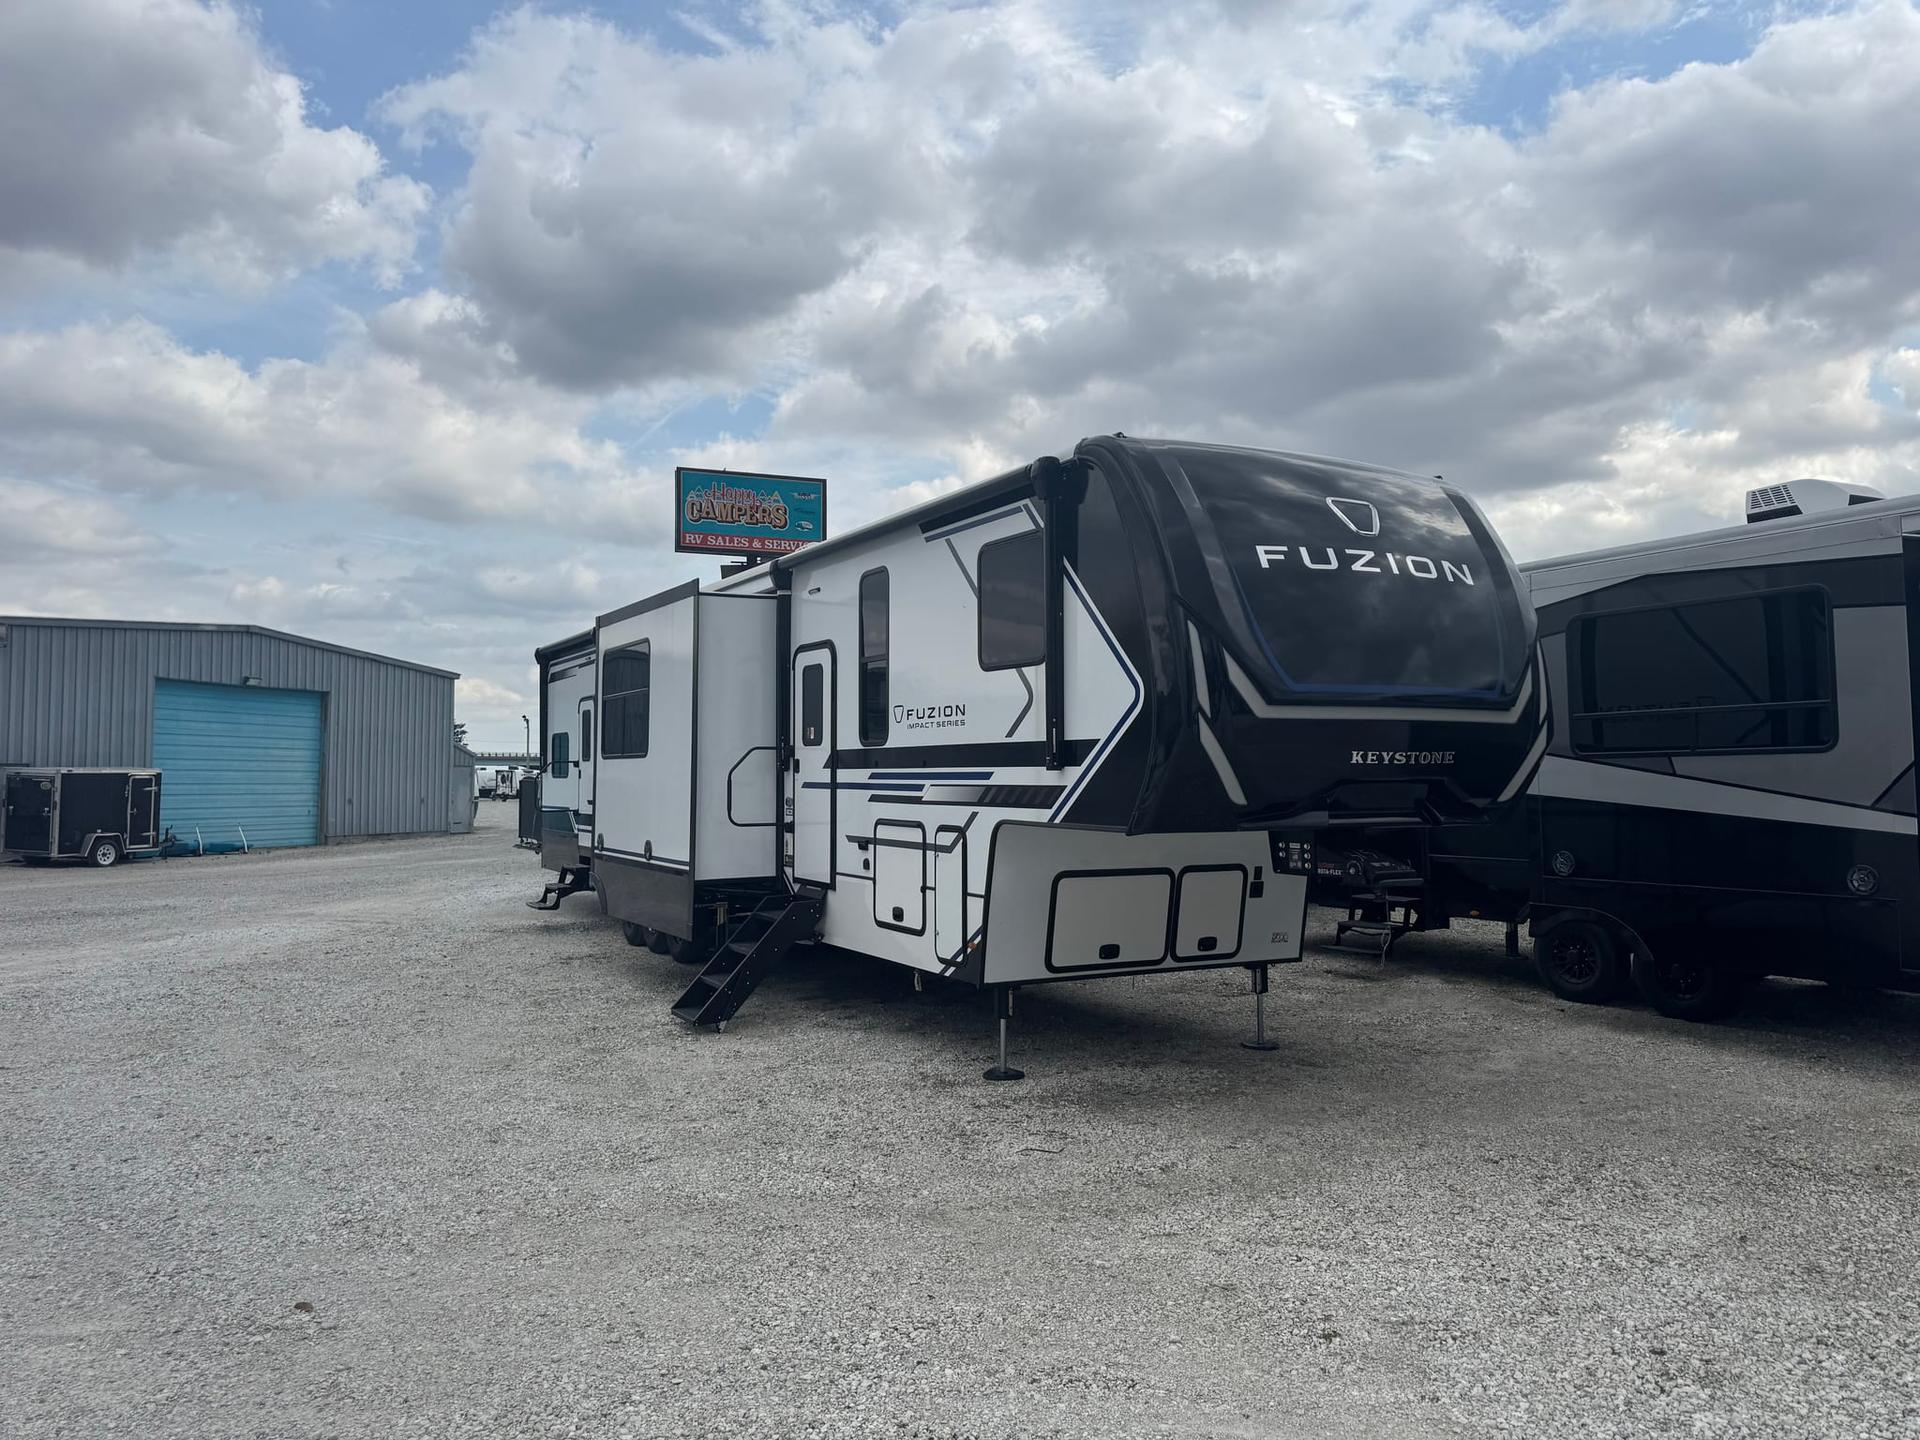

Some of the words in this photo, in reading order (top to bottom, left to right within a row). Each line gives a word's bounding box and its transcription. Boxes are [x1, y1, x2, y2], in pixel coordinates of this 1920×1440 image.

[704, 482, 762, 511] Happy
[686, 500, 788, 529] CAMPERS
[685, 533, 703, 545] RV
[707, 535, 749, 548] SALES
[752, 538, 762, 548] &
[765, 539, 809, 551] SERVI
[1255, 545, 1475, 586] FUZION
[906, 704, 966, 720] FUZION
[906, 721, 935, 730] IMPACT
[936, 719, 966, 728] SERIES
[1350, 750, 1456, 764] KEYSTONE
